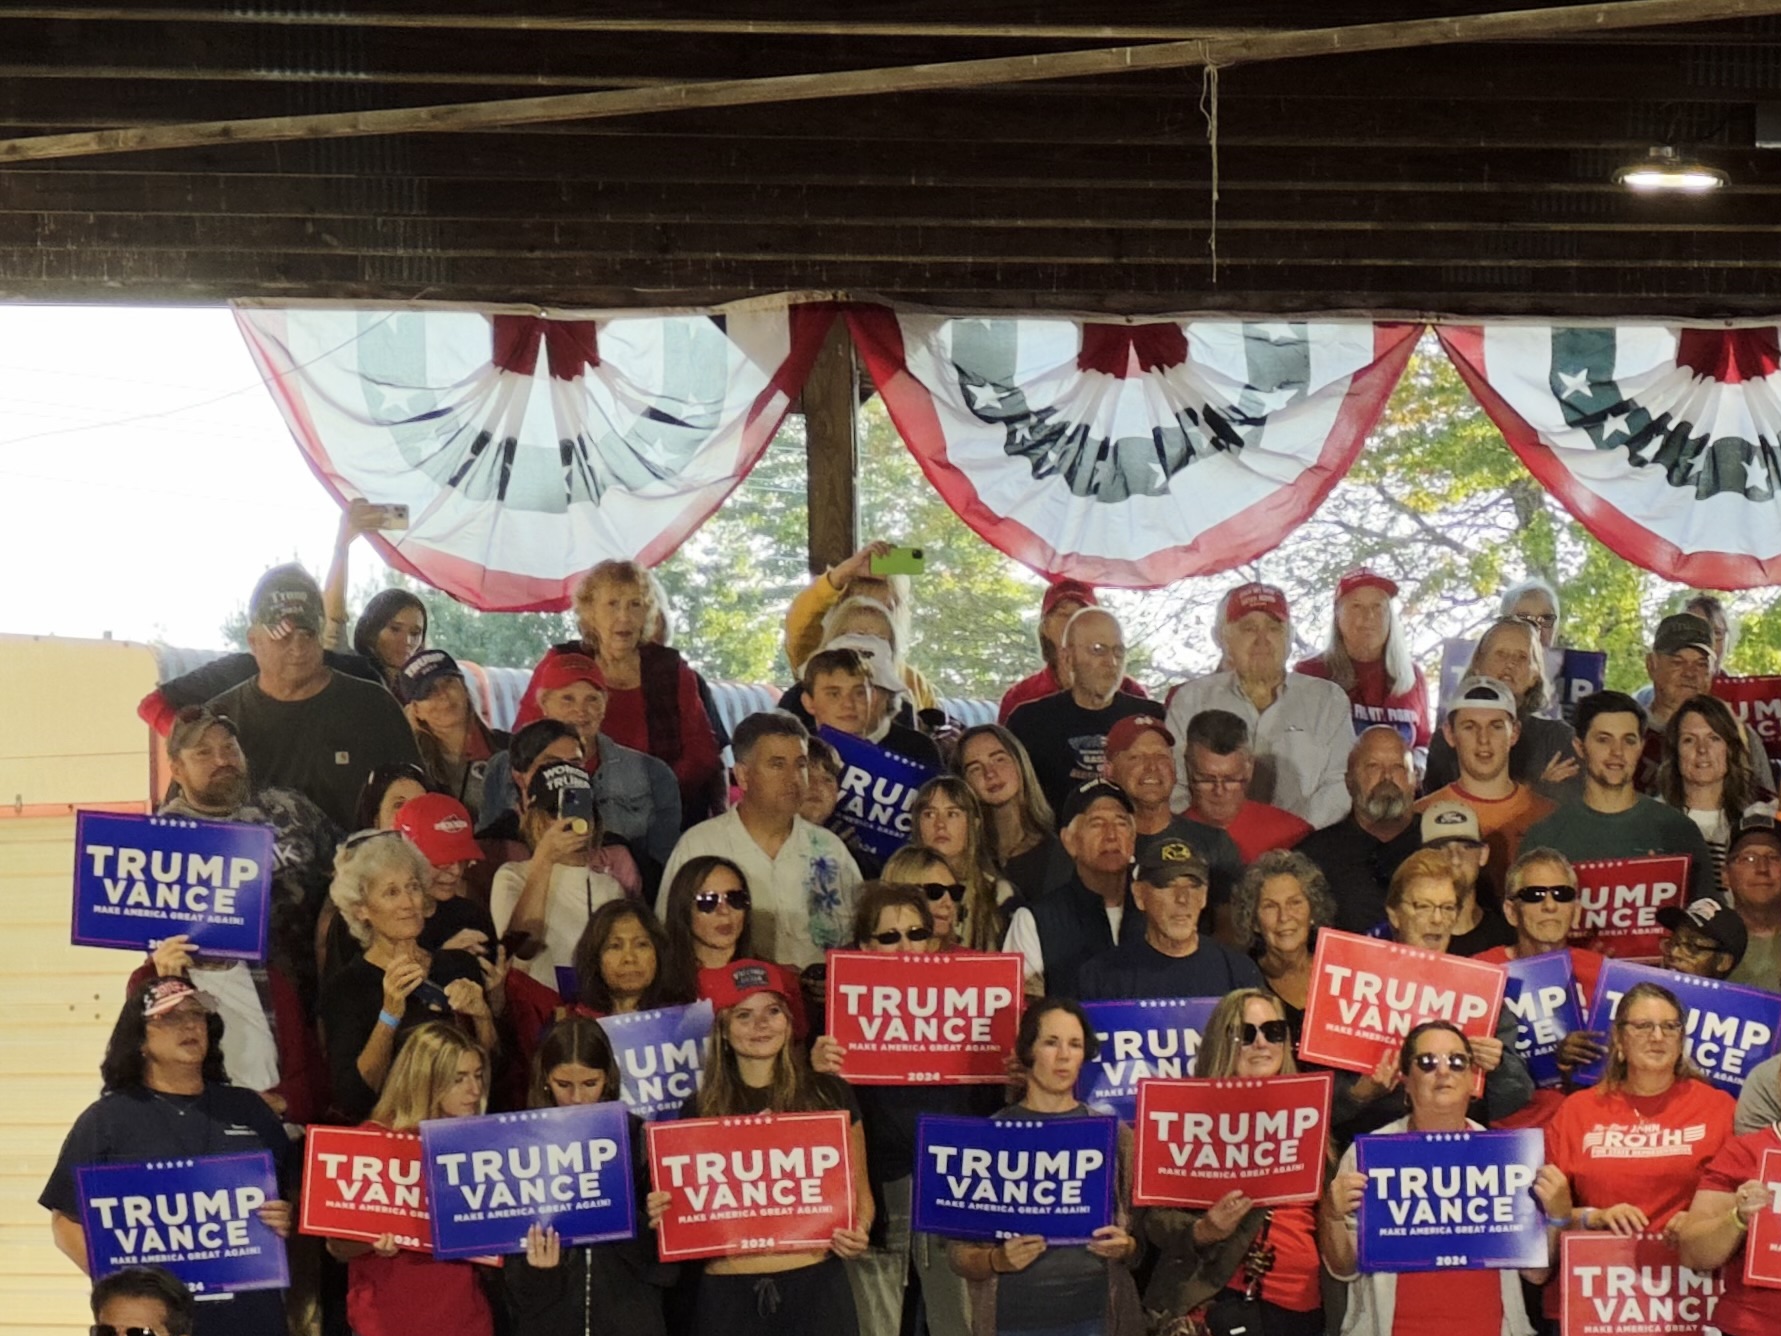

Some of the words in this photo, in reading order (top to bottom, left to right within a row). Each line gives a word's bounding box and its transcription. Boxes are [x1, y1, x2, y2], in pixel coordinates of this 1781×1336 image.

[86, 845, 259, 889] TRUMP
[102, 878, 237, 914] VANCE
[1580, 882, 1678, 910] UMP
[839, 985, 1012, 1017] TRUMP
[1324, 964, 1488, 1025] TRUMP
[858, 1017, 992, 1042] VANCE
[907, 1071, 940, 1082] 2024
[1149, 1107, 1320, 1144] TRUMP
[1603, 1128, 1683, 1147] ROTH
[317, 1153, 422, 1186] TRU
[436, 1138, 618, 1186] TRUMP
[661, 1146, 840, 1188] TRUMP
[928, 1145, 1104, 1180] TRUMP
[1168, 1139, 1300, 1168] VANCE
[335, 1180, 424, 1208] VAN
[460, 1172, 601, 1210] VANCE
[683, 1178, 823, 1211] VANCE
[946, 1176, 1082, 1205] VANCE
[1368, 1164, 1533, 1199] TRUMP
[90, 1186, 265, 1229] TRUMP
[678, 1213, 706, 1224] MAKE
[709, 1210, 757, 1221] AMERICA
[760, 1206, 794, 1216] GREAT
[1387, 1196, 1515, 1225] VANCE
[114, 1220, 250, 1255] VANCE
[394, 1235, 420, 1247] 024
[740, 1238, 775, 1249] 2024
[1435, 1256, 1468, 1266] 2024
[1574, 1265, 1712, 1297] TRUM
